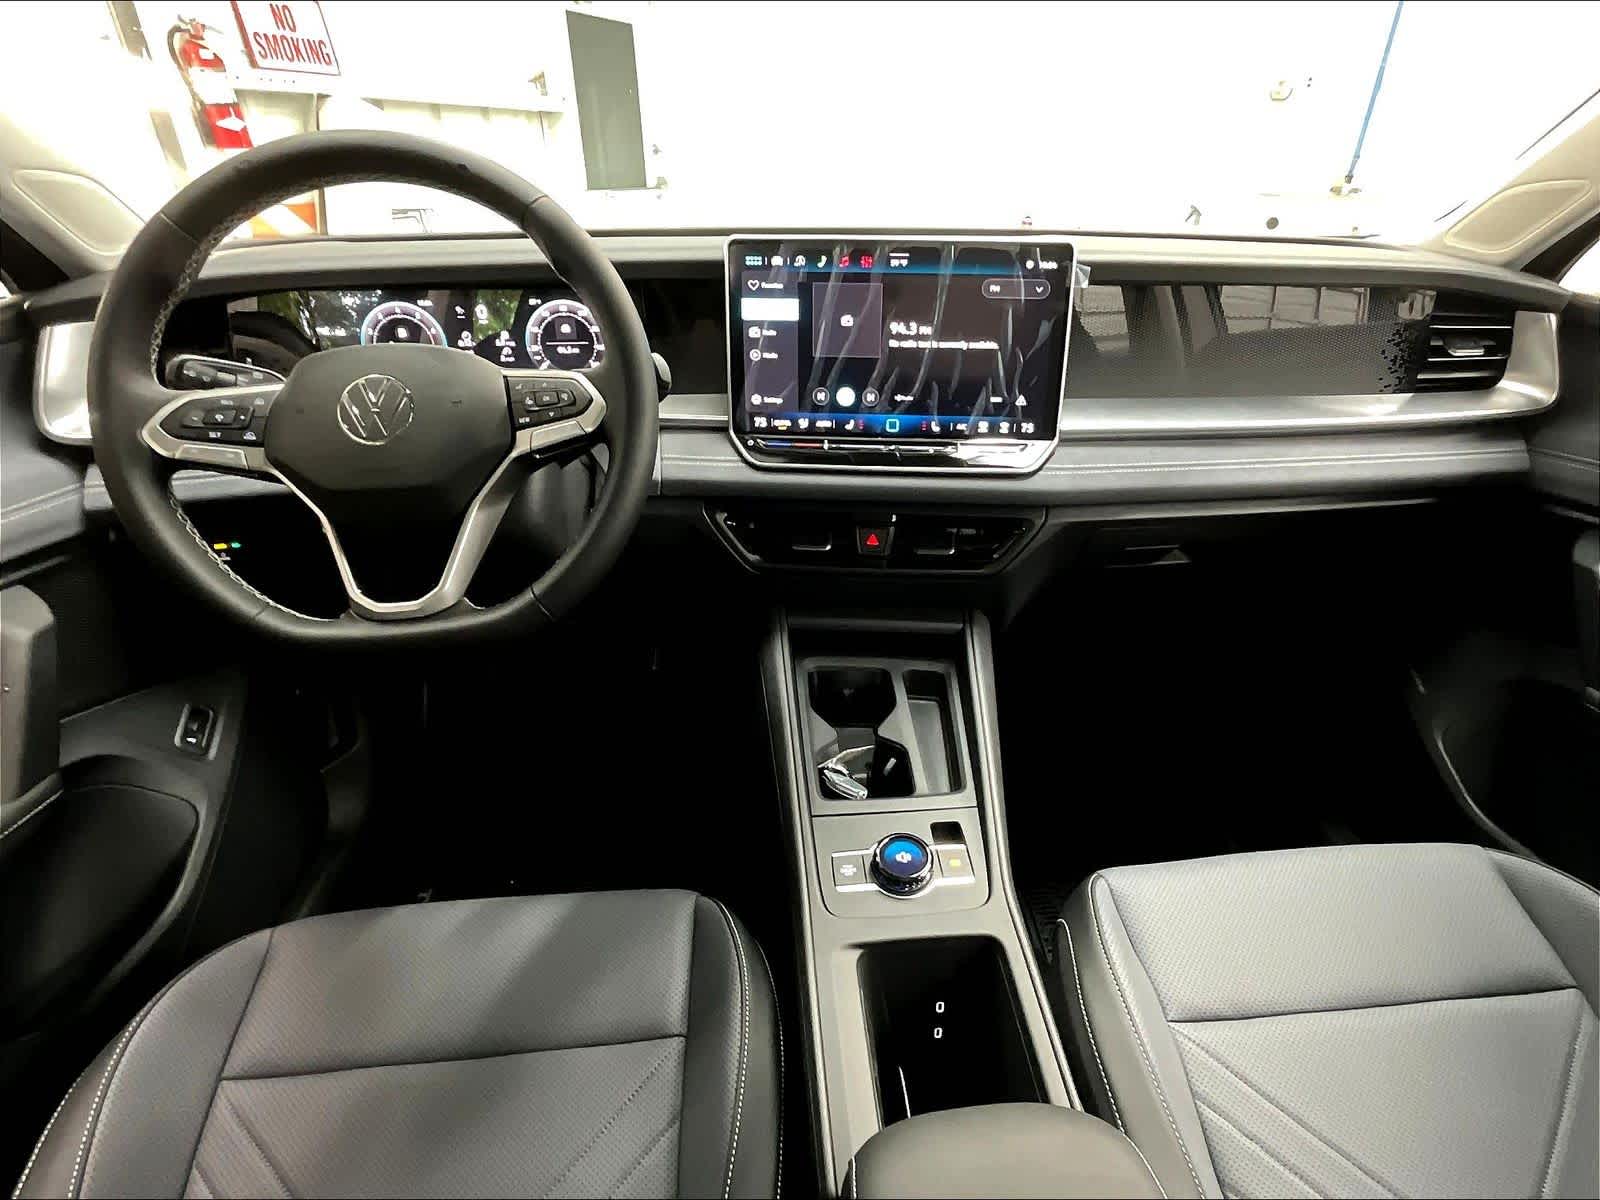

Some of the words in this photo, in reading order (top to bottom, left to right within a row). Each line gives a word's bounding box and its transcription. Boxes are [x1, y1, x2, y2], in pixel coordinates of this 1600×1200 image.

[269, 3, 296, 32] NO
[253, 32, 332, 65] SMOKING
[889, 322, 917, 335] 94.3
